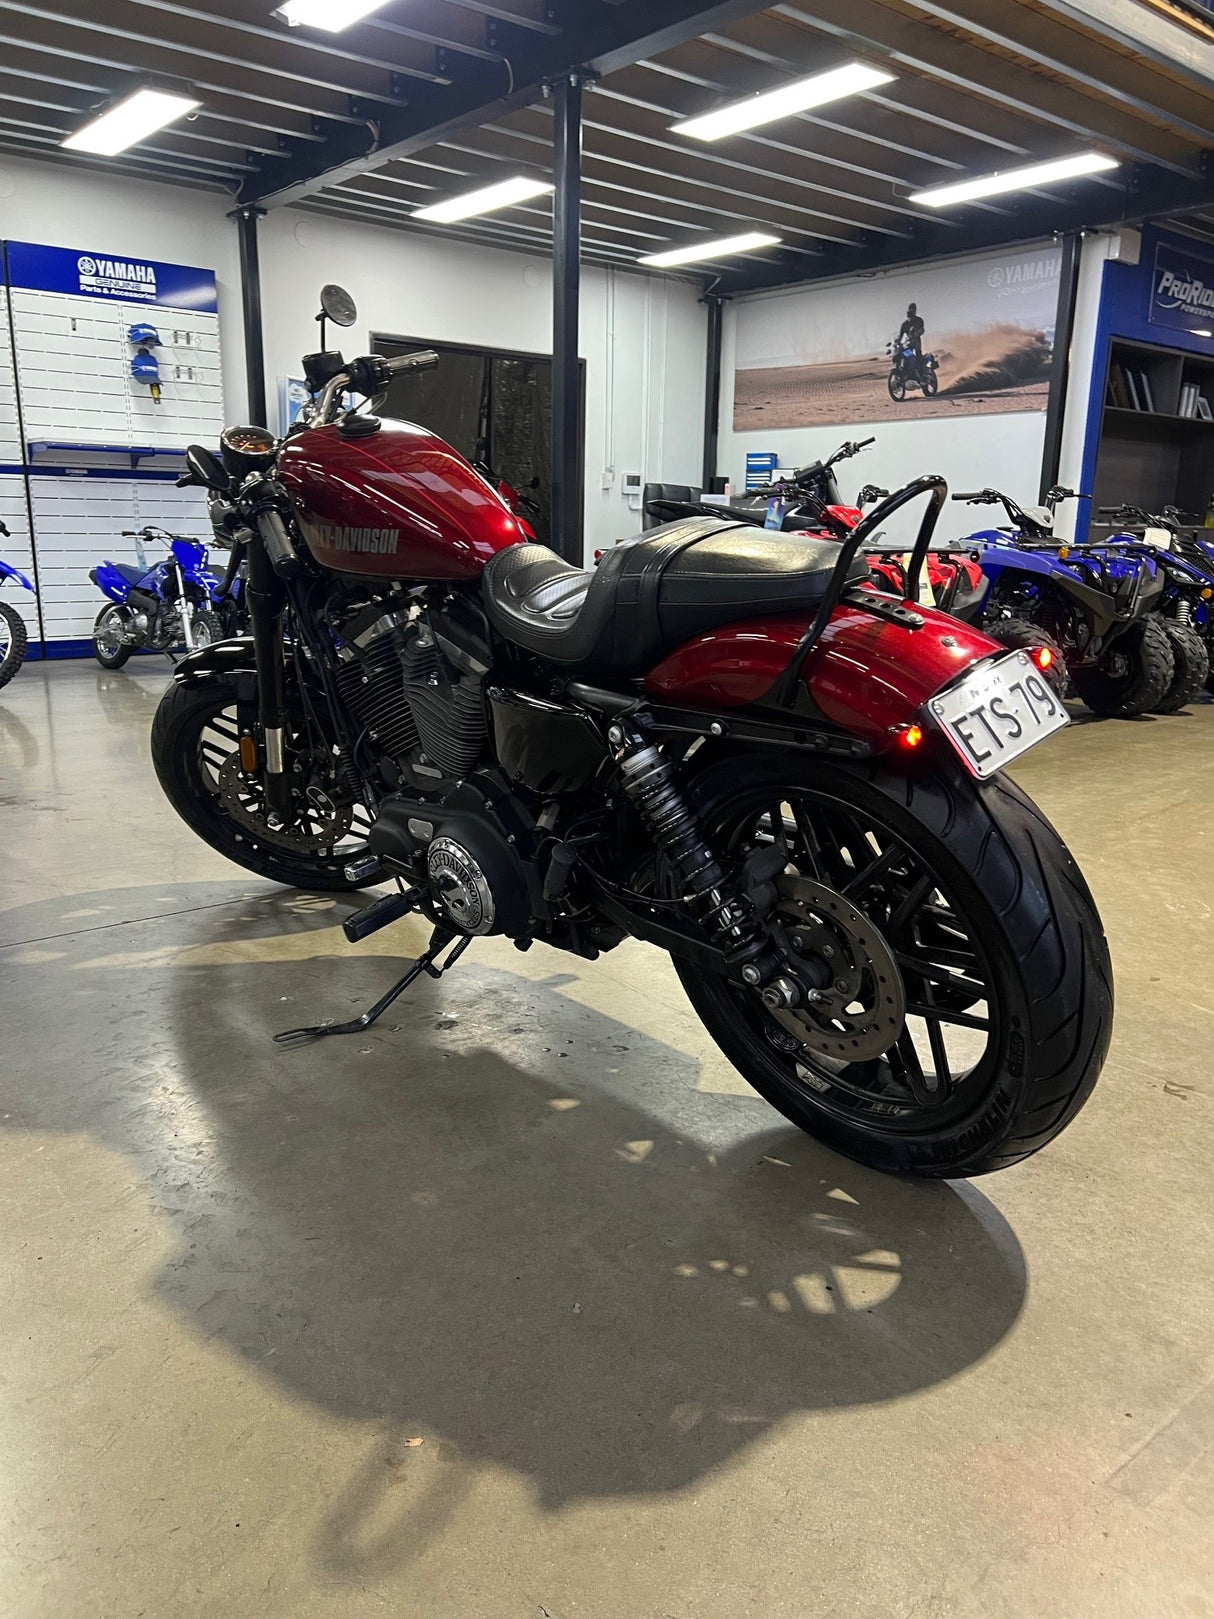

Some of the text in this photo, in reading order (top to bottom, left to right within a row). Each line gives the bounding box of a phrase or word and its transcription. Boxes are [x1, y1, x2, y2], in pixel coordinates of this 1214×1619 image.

[95, 259, 157, 283] YAMAHA
[80, 284, 102, 293] Parts
[110, 288, 157, 300] Accessories
[95, 277, 142, 291] GENUINE
[1157, 271, 1214, 307] PRORID
